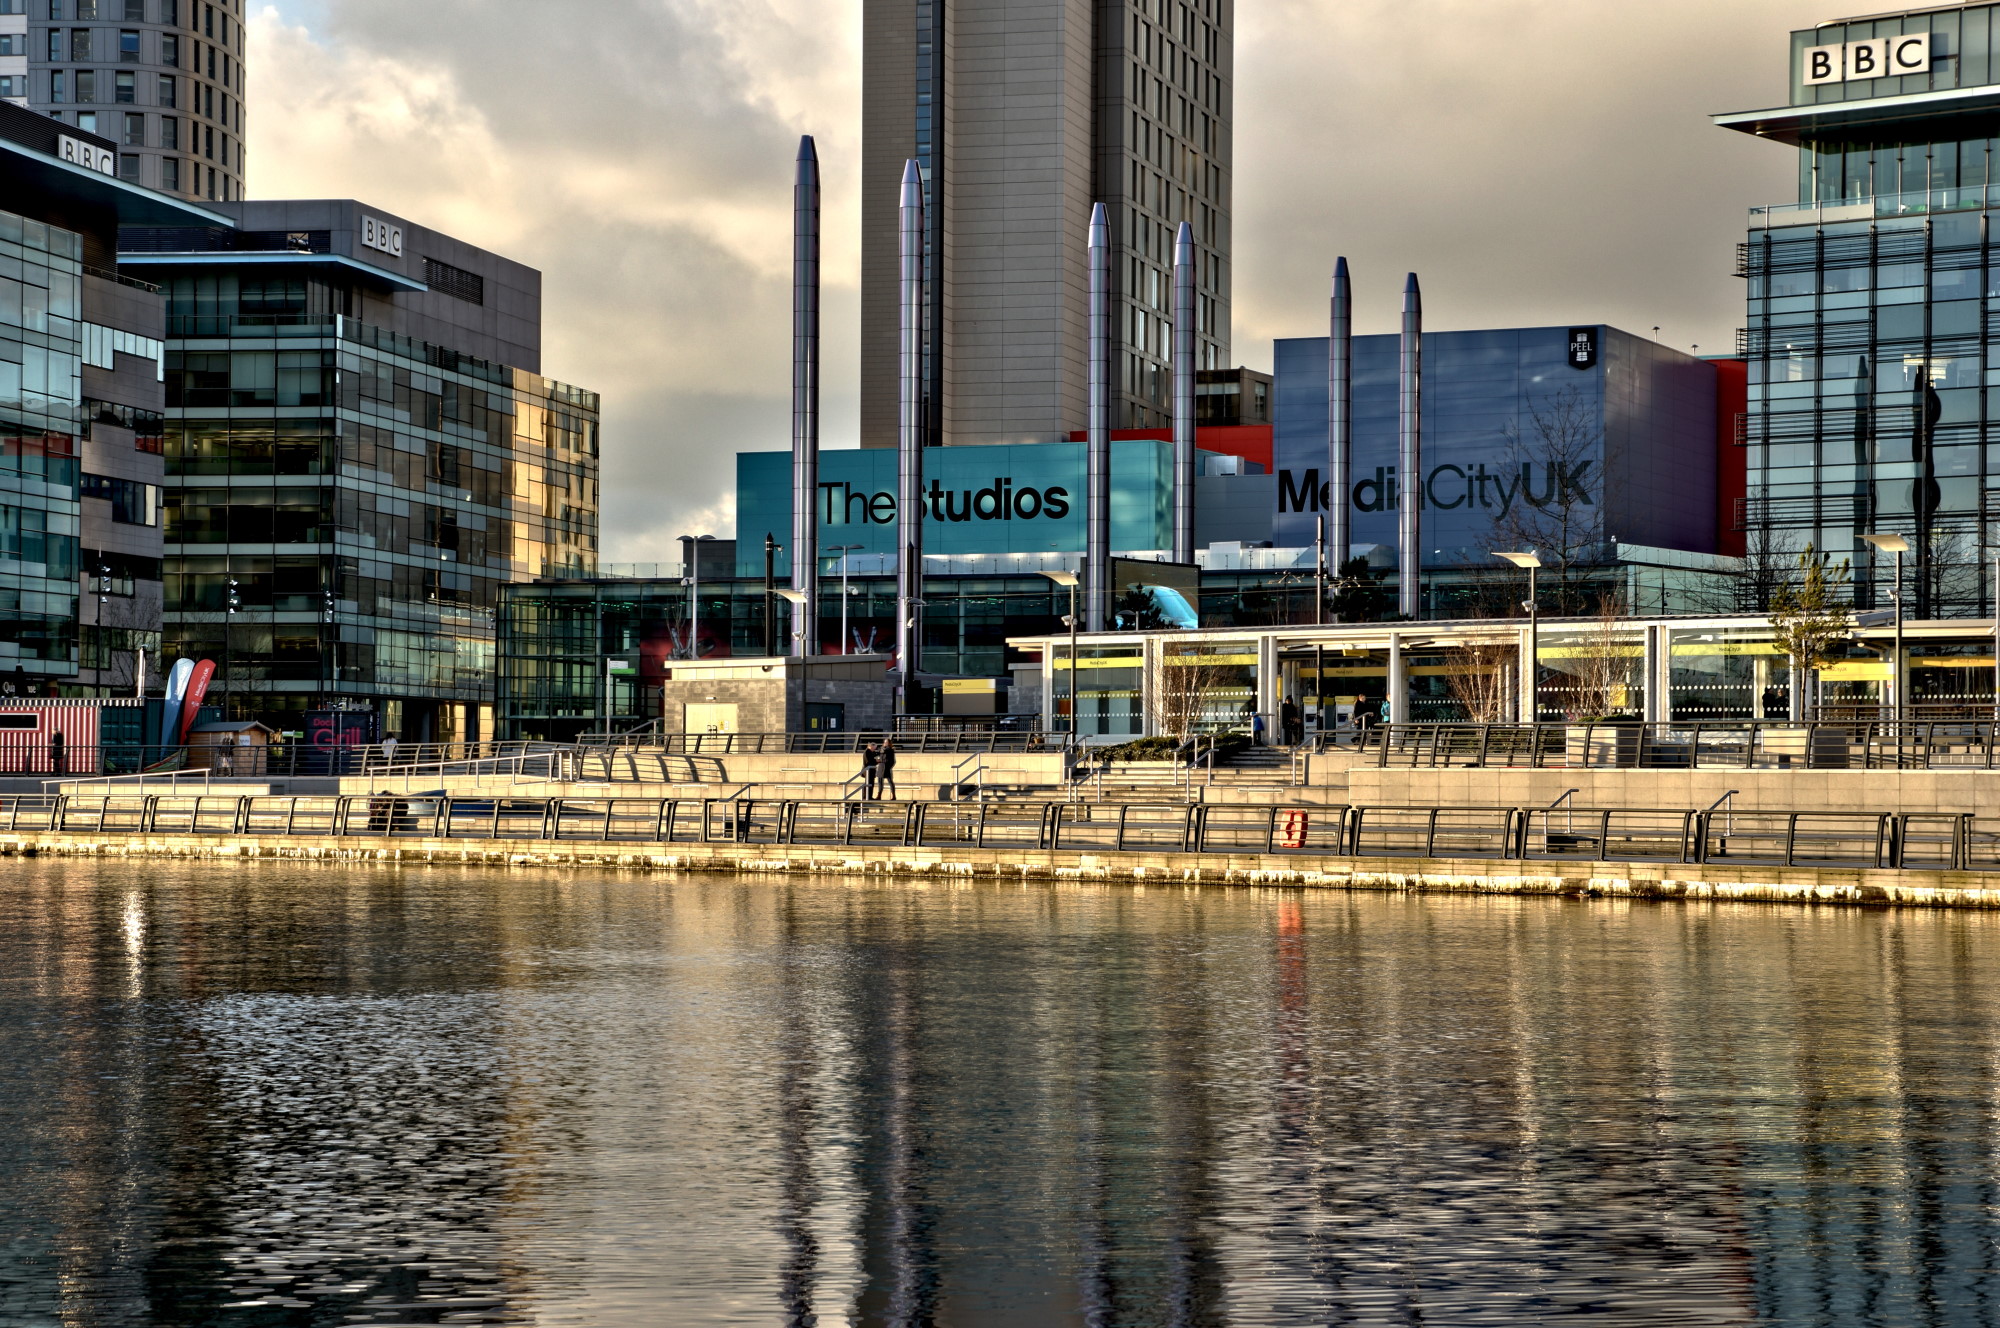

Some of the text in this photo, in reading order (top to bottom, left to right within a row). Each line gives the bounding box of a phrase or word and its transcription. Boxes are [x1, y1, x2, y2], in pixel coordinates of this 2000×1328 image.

[1811, 39, 1922, 79] BBC
[66, 140, 111, 173] BBC
[367, 220, 400, 252] BBC
[1570, 342, 1593, 352] PEEL
[818, 477, 1069, 525] The tudios
[1277, 460, 1594, 520] MdiCityUK
[313, 727, 360, 751] Grill
